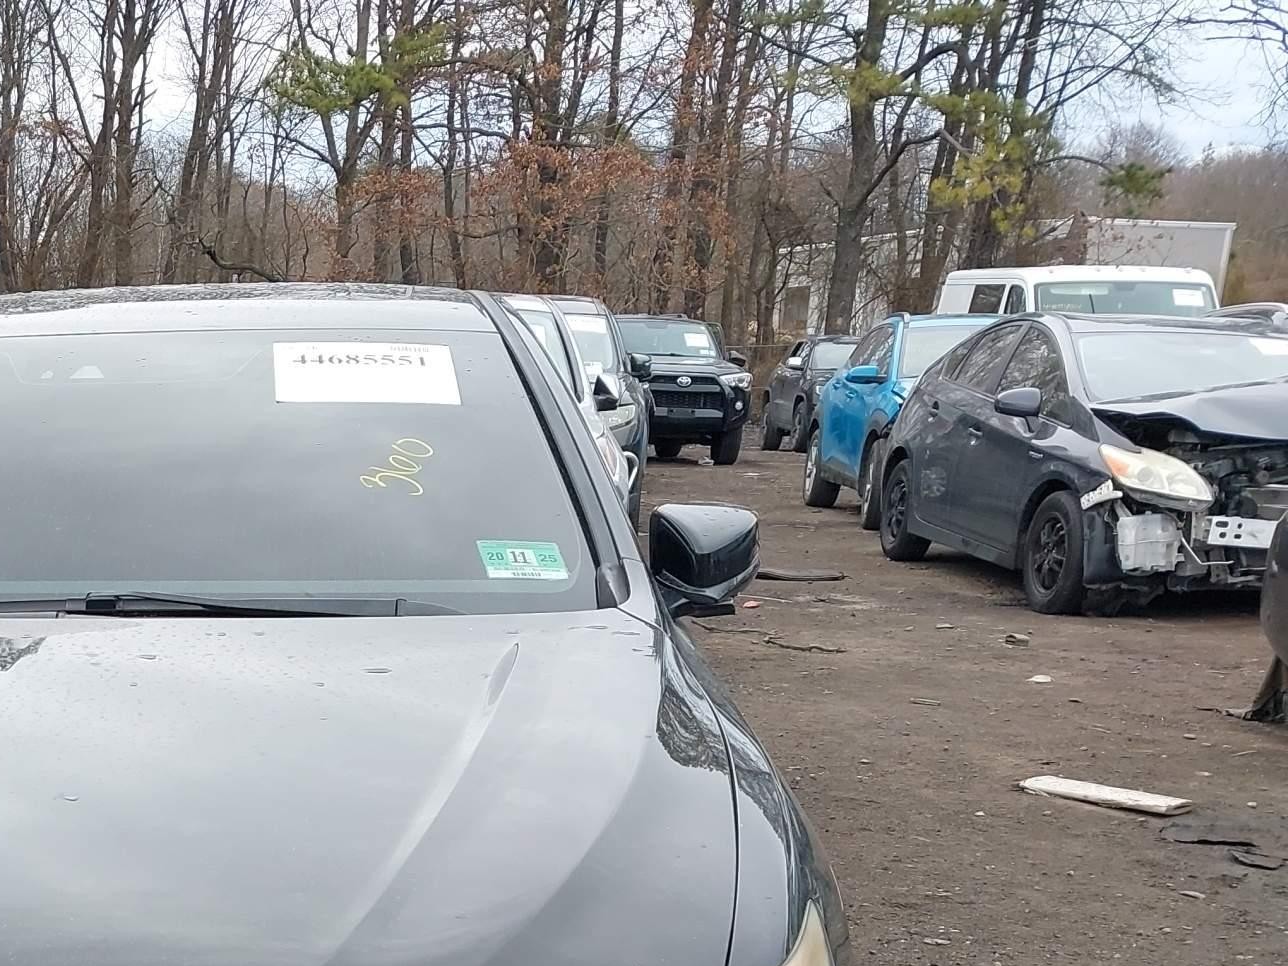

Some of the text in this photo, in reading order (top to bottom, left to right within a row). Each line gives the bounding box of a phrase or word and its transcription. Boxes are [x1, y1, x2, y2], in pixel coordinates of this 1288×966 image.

[292, 354, 426, 367] 44685551
[487, 551, 558, 564] 20 11 25
